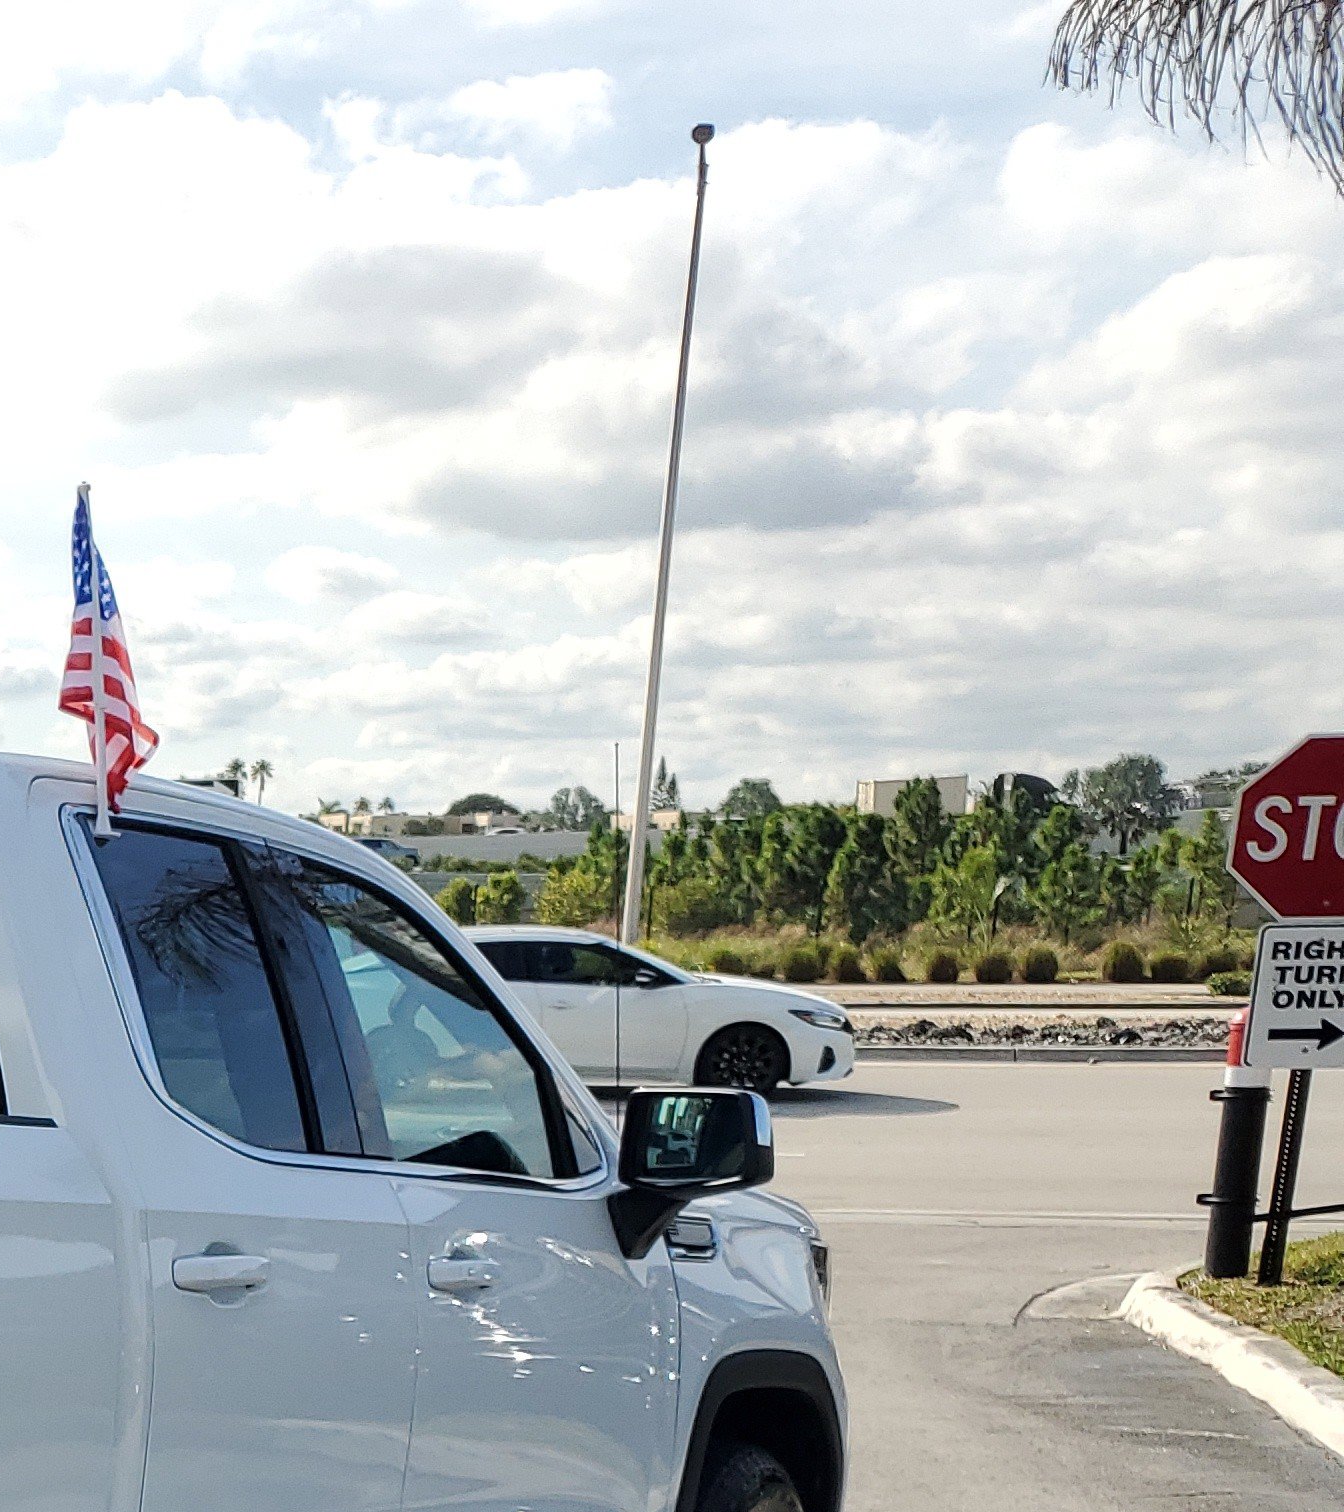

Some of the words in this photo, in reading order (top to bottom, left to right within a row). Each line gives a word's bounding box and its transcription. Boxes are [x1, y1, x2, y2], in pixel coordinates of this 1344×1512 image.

[1245, 795, 1344, 862] ST
[1271, 938, 1344, 961] RIGH
[1275, 964, 1344, 985] TUR
